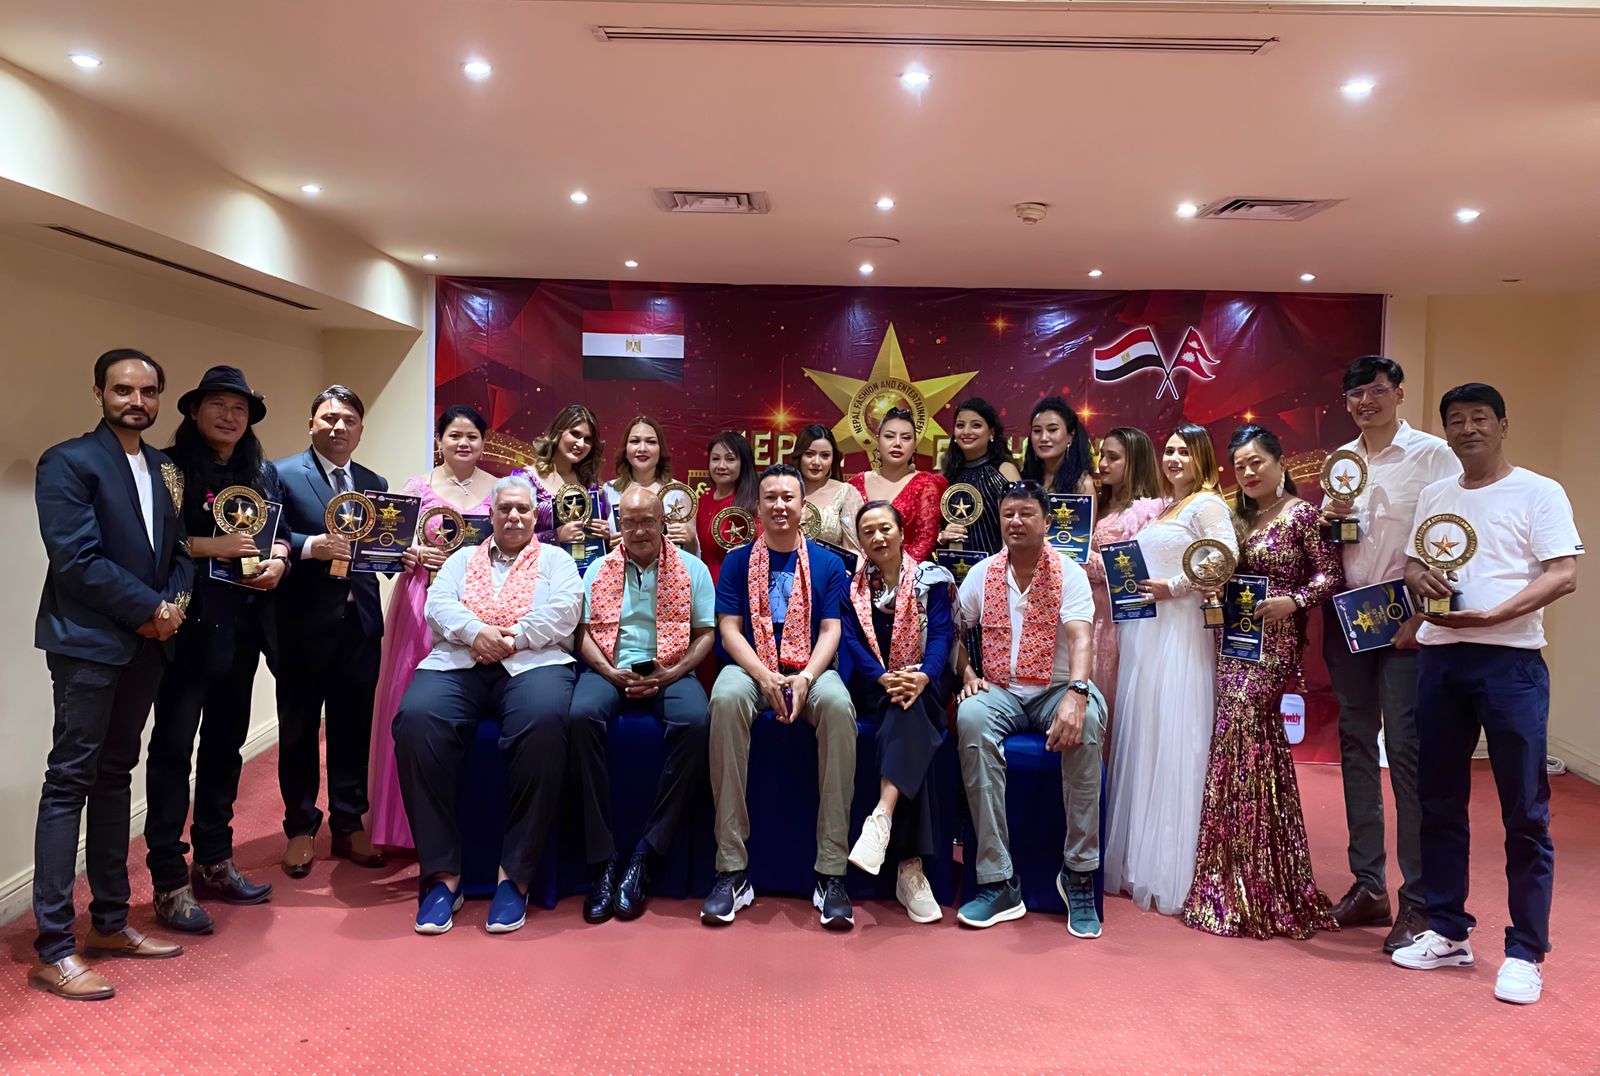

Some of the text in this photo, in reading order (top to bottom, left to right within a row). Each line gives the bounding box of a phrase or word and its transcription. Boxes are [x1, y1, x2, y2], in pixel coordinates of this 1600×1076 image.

[852, 379, 925, 434] NEPAL FASHION AND ENTERTAINMENT
